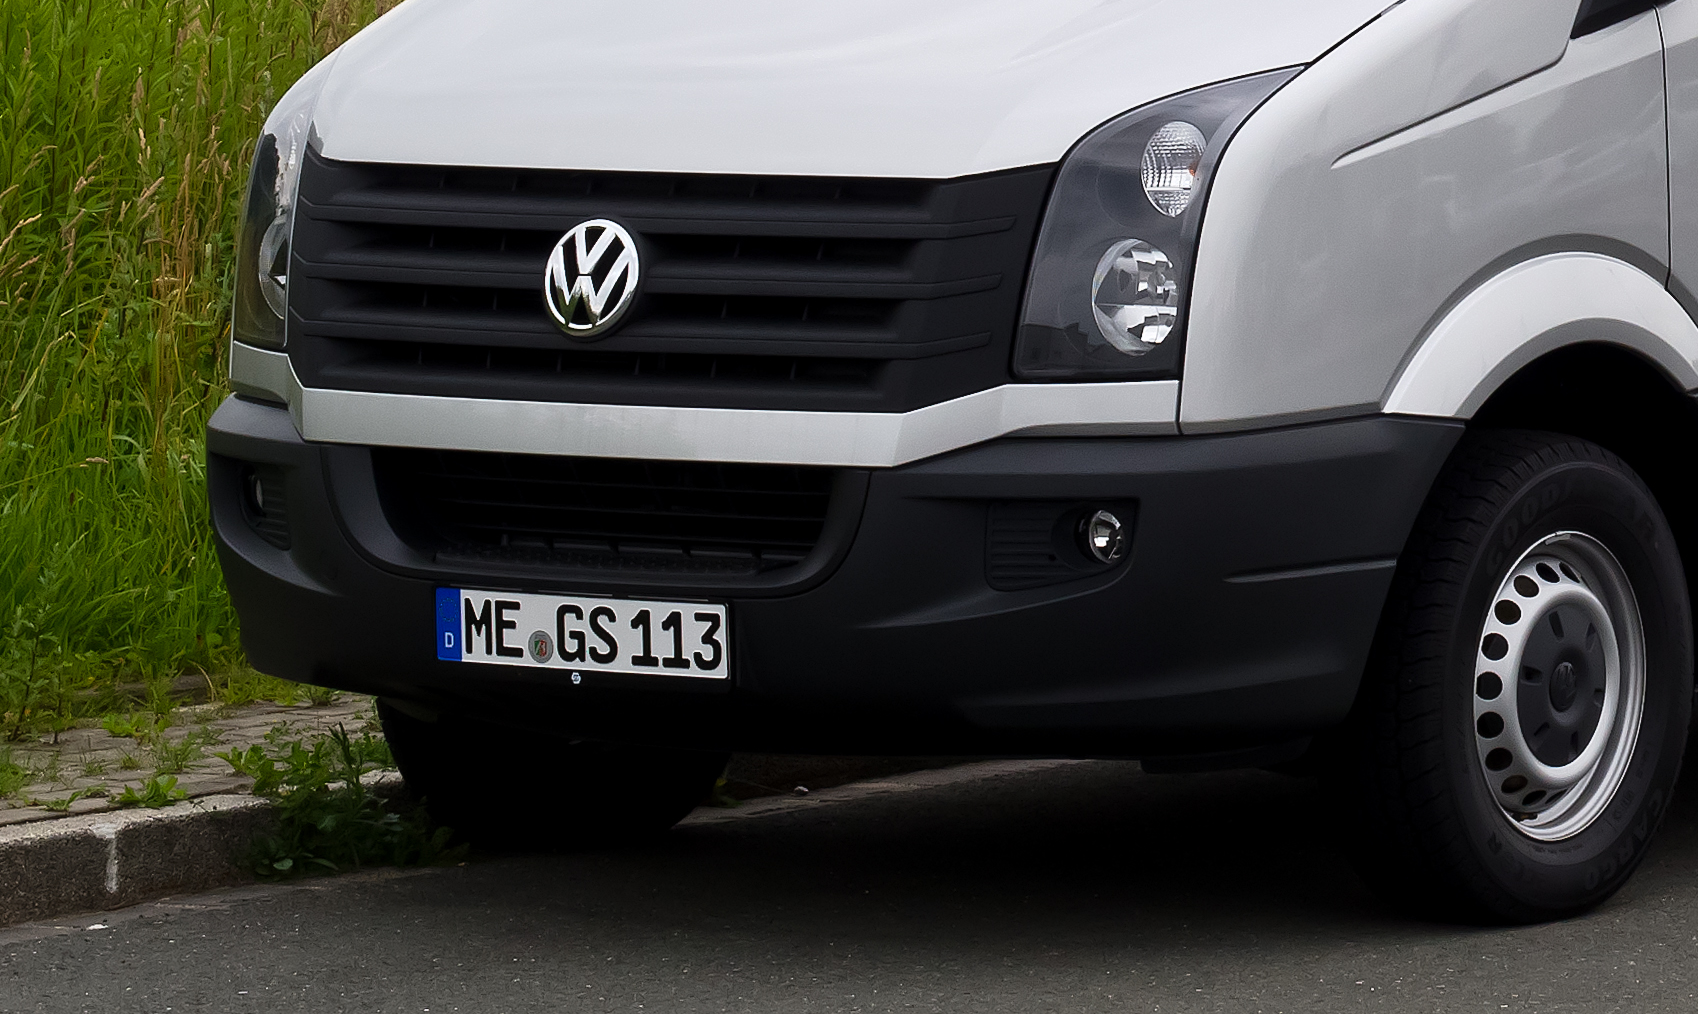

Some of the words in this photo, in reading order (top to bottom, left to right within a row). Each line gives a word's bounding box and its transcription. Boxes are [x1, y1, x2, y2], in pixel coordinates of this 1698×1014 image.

[545, 219, 639, 335] VW
[444, 631, 455, 649] D
[463, 596, 525, 659] ME
[556, 603, 619, 664] GS
[630, 608, 723, 671] 113
